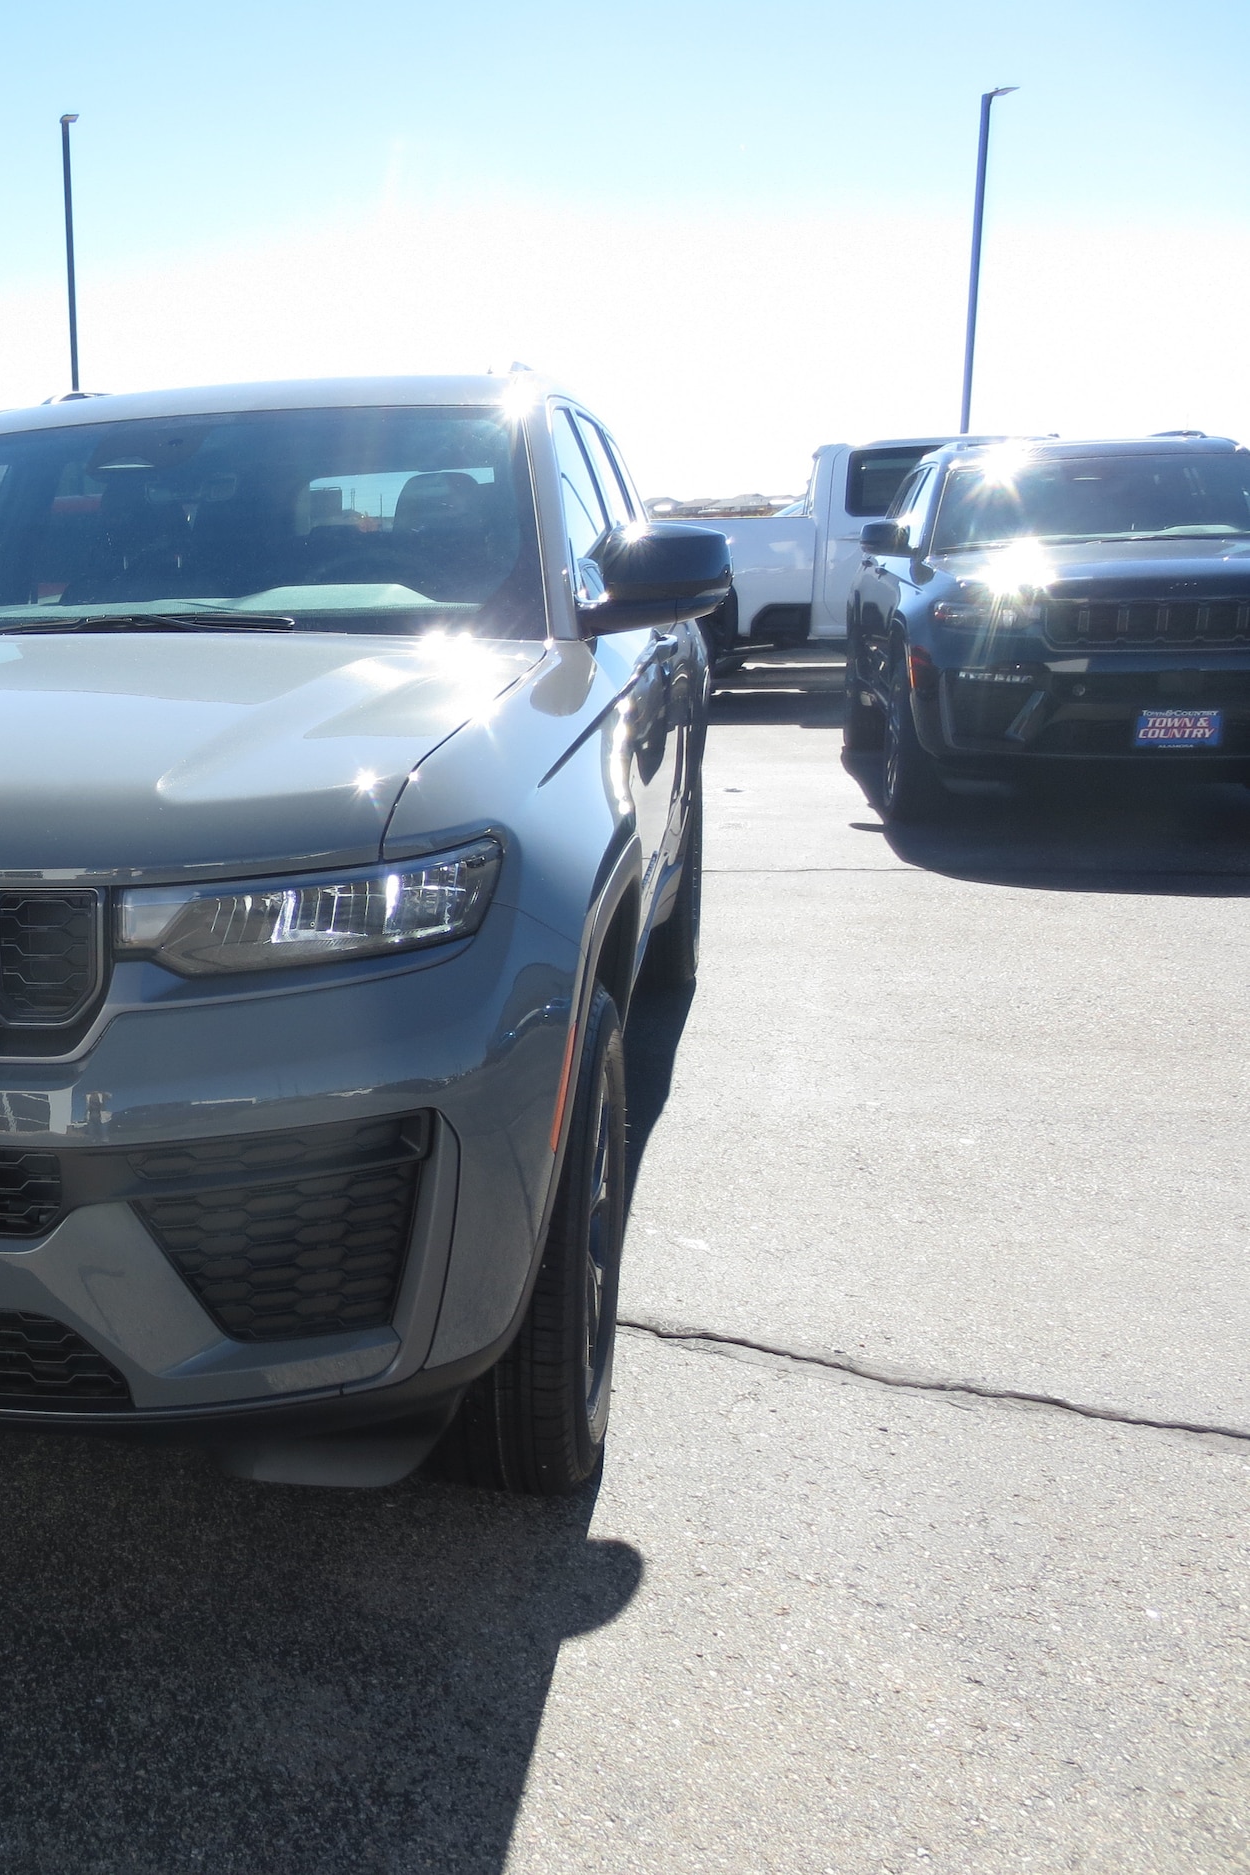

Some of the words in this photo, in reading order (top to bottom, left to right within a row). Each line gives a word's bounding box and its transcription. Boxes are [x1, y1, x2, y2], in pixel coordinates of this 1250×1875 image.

[1147, 717, 1195, 728] TOWN
[1196, 717, 1210, 728] &
[1138, 728, 1215, 739] COUNTRY
